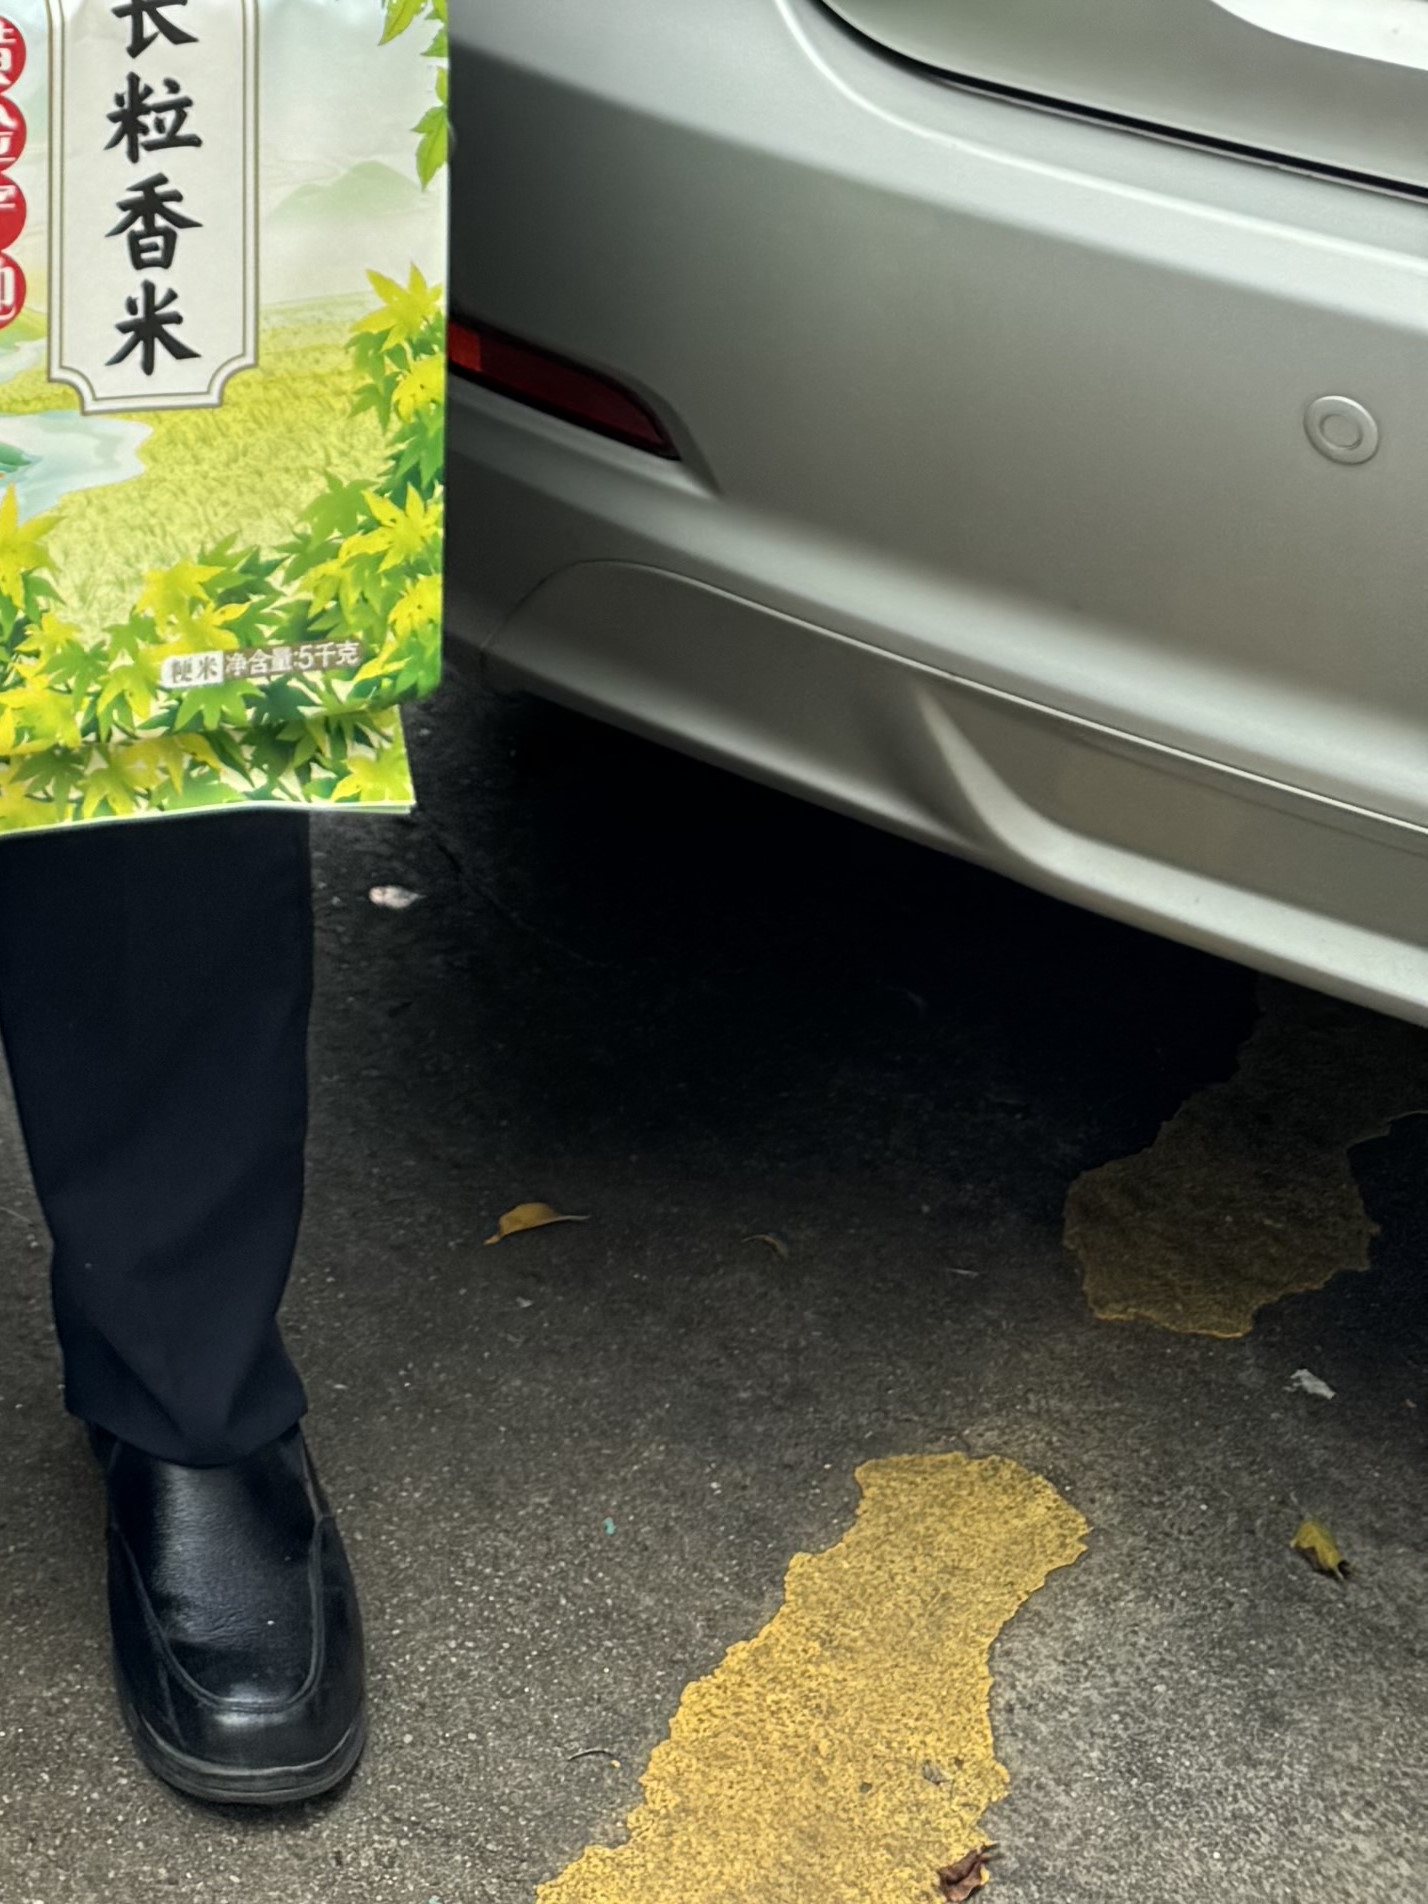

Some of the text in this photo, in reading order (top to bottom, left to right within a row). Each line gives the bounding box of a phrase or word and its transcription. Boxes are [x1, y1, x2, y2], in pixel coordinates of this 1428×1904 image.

[225, 640, 361, 678] 净含量:5千克
